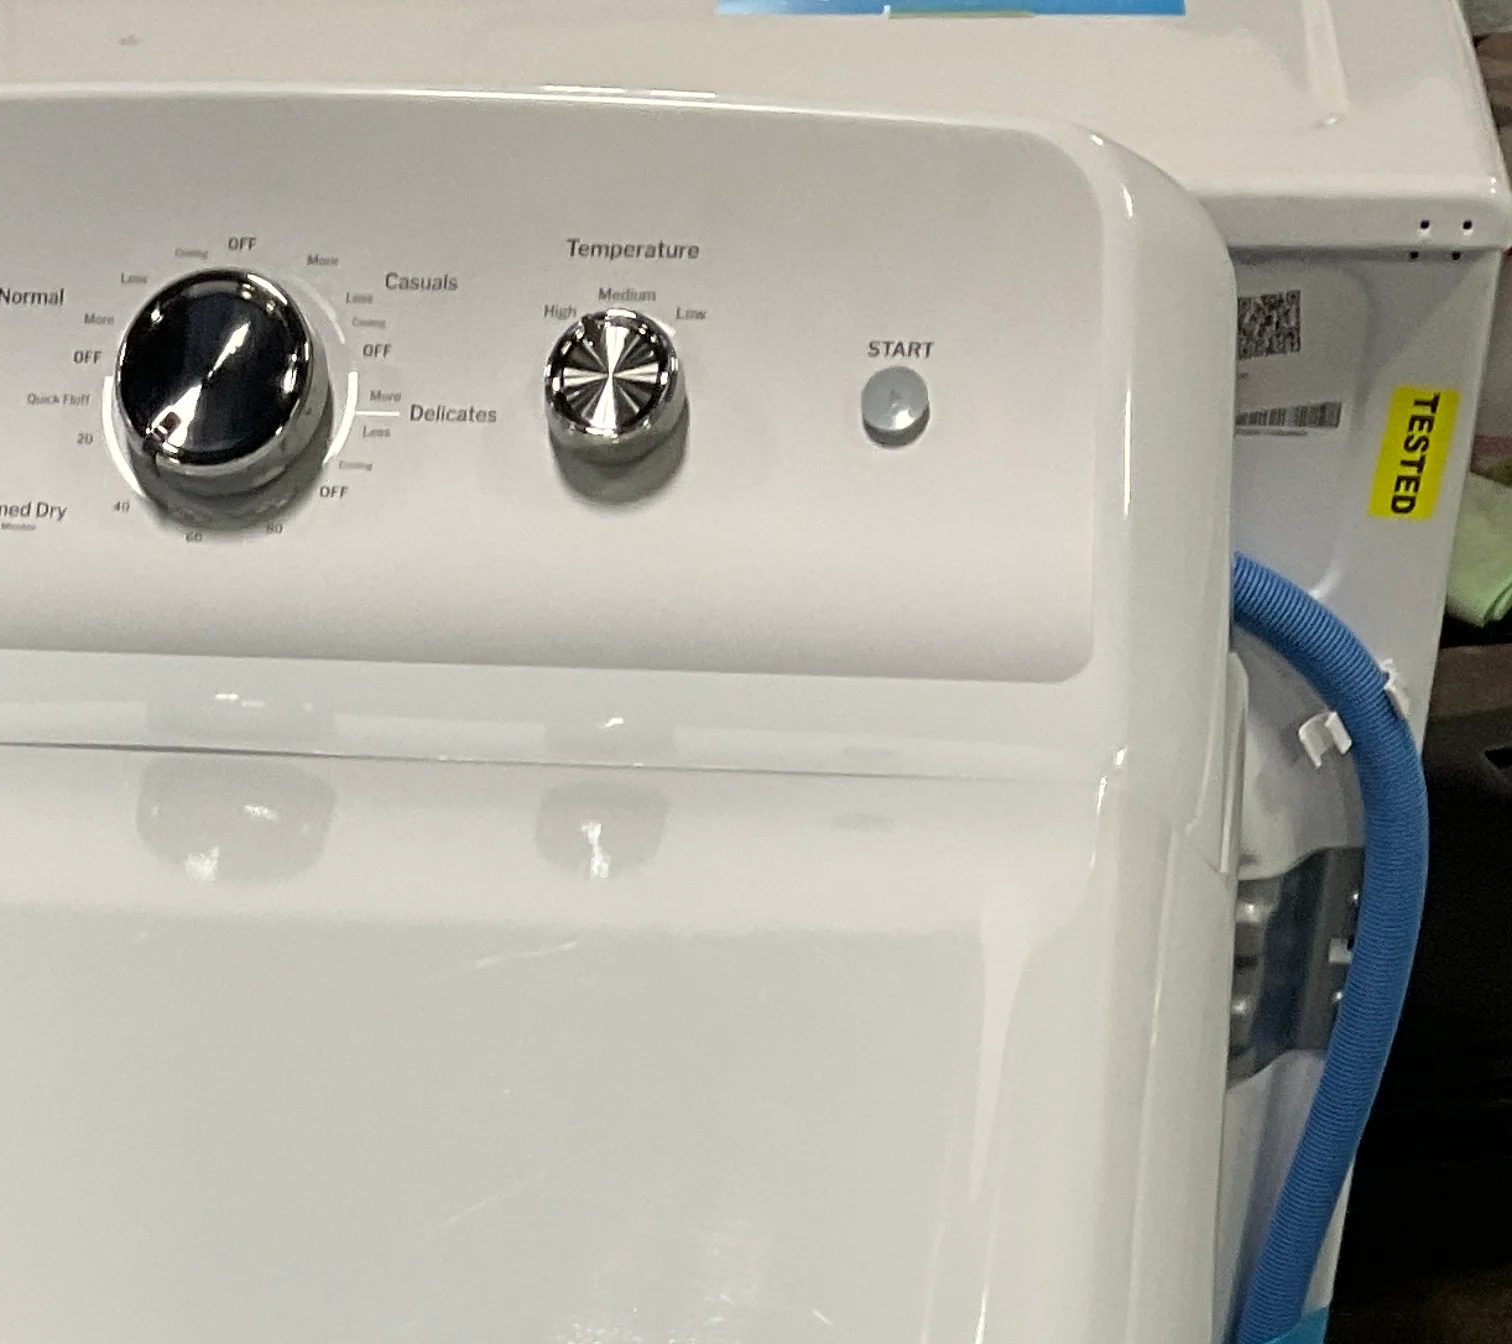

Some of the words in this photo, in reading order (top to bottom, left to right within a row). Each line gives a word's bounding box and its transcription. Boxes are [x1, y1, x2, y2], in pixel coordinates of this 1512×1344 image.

[228, 236, 257, 251] OFF
[567, 238, 700, 260] Temperature
[385, 272, 458, 291] Casuals
[598, 287, 657, 302] Medium
[84, 312, 115, 325] More
[544, 304, 577, 320] High
[676, 306, 707, 320] Low
[362, 344, 392, 358] OFF
[867, 340, 935, 359] START
[73, 350, 102, 364] OFF
[27, 393, 60, 406] Quick
[410, 404, 497, 423] Delicates
[76, 431, 94, 445] 20
[363, 425, 391, 438] Less
[1391, 392, 1441, 515] TESTED
[319, 485, 349, 499] OFF
[36, 501, 67, 521] Dry
[113, 501, 130, 513] 40
